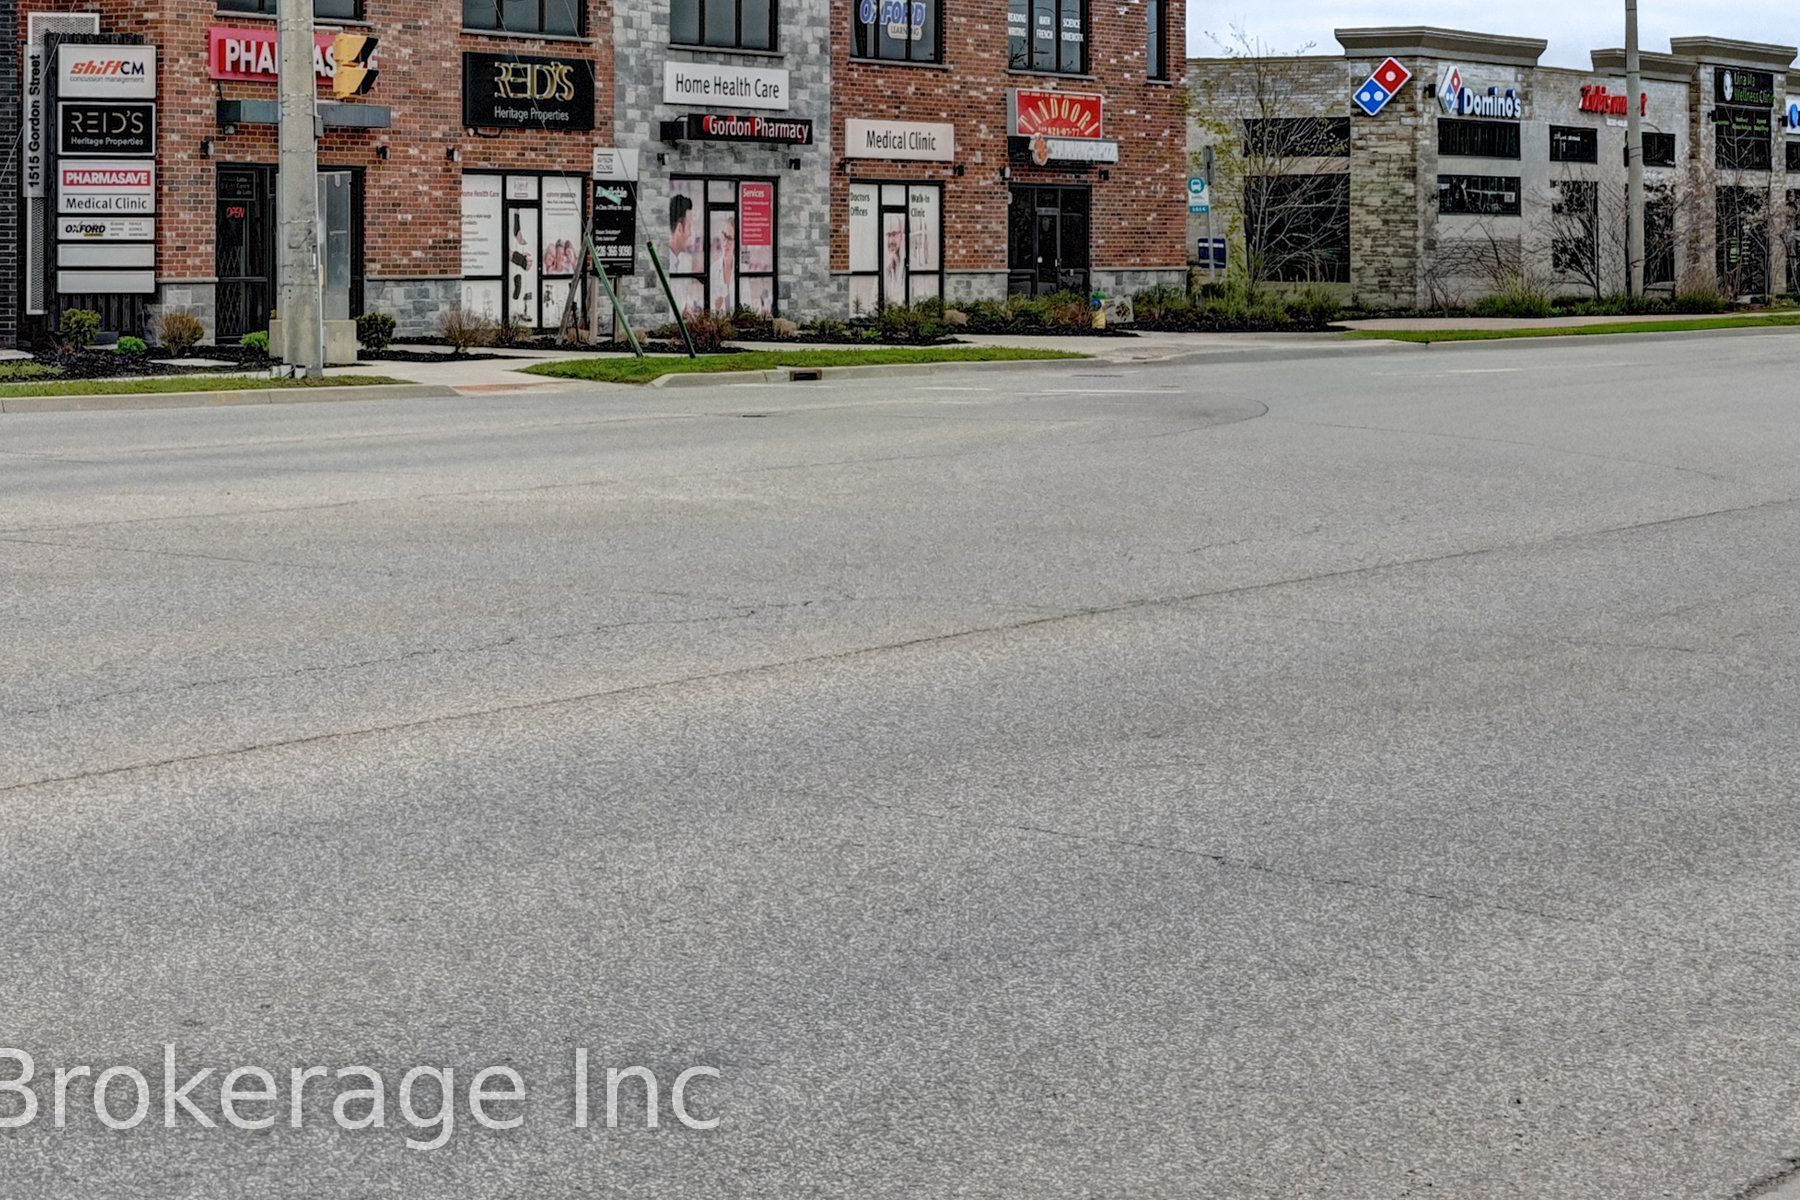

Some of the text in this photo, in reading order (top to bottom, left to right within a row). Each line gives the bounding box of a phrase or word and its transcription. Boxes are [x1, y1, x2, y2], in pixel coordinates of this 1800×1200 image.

[676, 73, 779, 99] Home Health Care
[1462, 87, 1521, 118] Domino's
[28, 54, 40, 188] 1515 Gordon Street
[71, 110, 143, 133] REID'S
[494, 105, 569, 123] Heritage Properties
[1019, 98, 1099, 136] TANDOORI
[708, 115, 809, 144] Gordon Pharmacy
[71, 137, 143, 146] Heritage Properties
[867, 130, 936, 151] Medical Clinic
[66, 172, 148, 184] PHARMASAVE
[743, 188, 765, 198] Services
[66, 198, 147, 209] Medical Clinic
[227, 206, 245, 218] OPEN
[911, 208, 926, 218] Clinic
[65, 223, 106, 234] OXFORD
